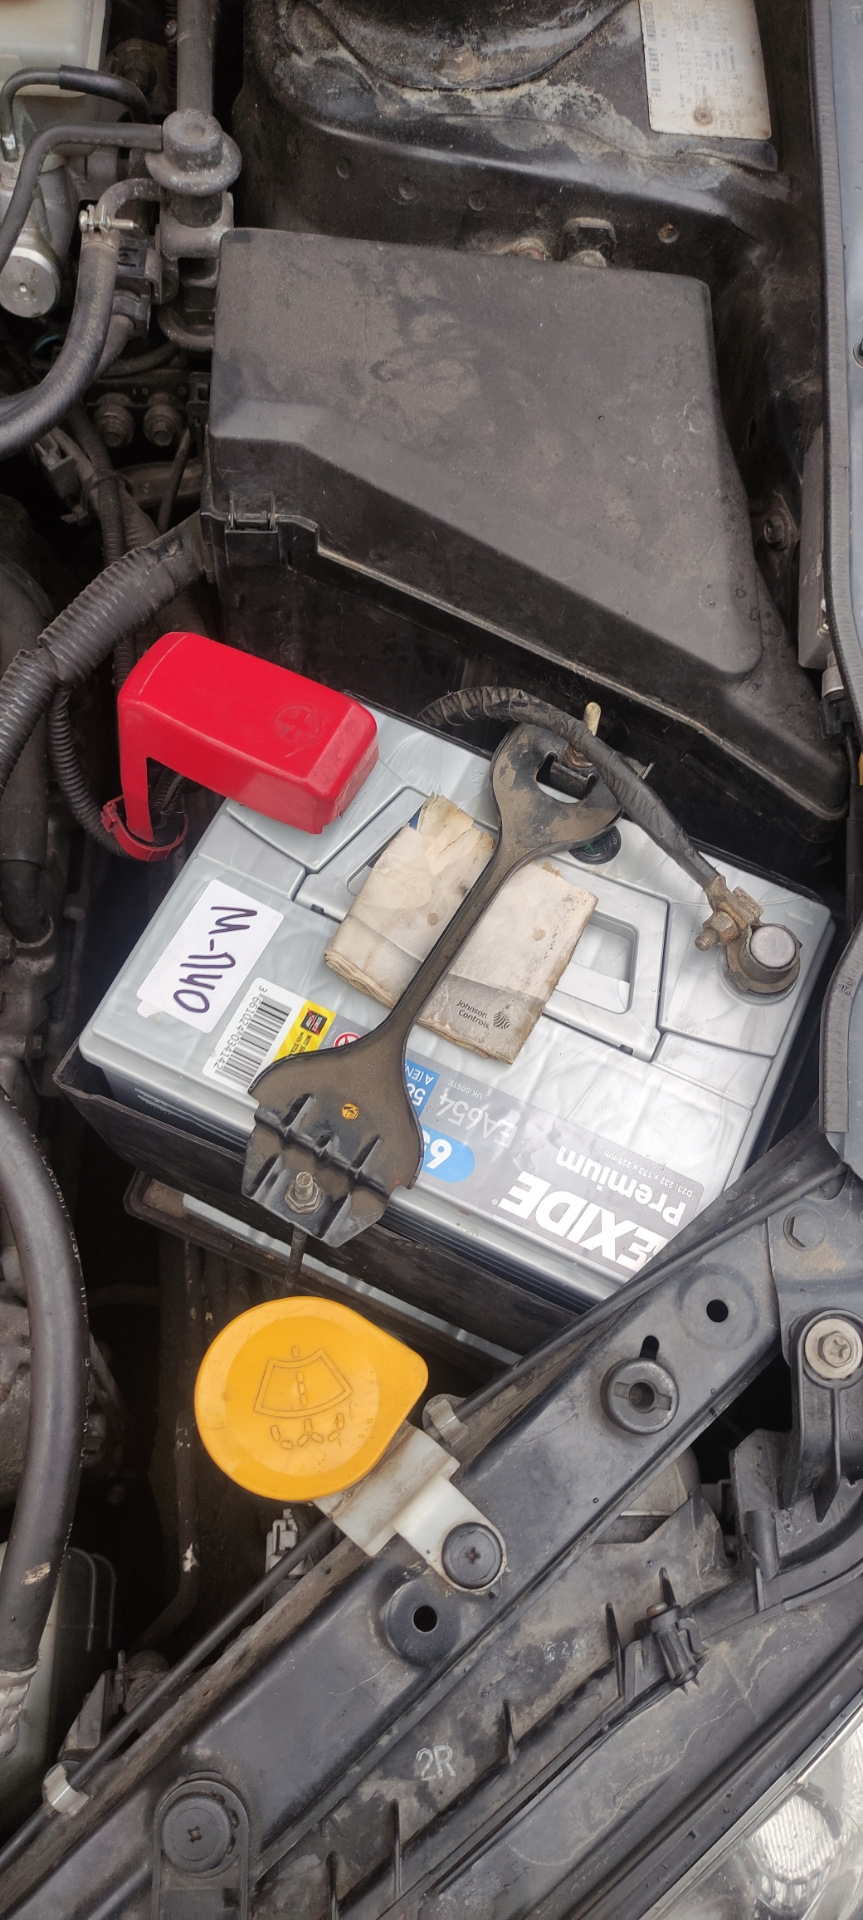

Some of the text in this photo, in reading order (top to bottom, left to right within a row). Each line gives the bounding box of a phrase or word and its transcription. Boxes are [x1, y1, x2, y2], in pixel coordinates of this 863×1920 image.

[237, 997, 260, 1034] 661024
[456, 1000, 487, 1018] Johnson
[214, 1035, 240, 1070] 034142
[405, 1063, 424, 1082] (EN
[435, 1093, 518, 1148] EA654
[555, 1146, 686, 1226] Premium
[660, 1177, 673, 1188] 232
[498, 1170, 668, 1272] EXIDE
[416, 1744, 456, 1781] 2R
